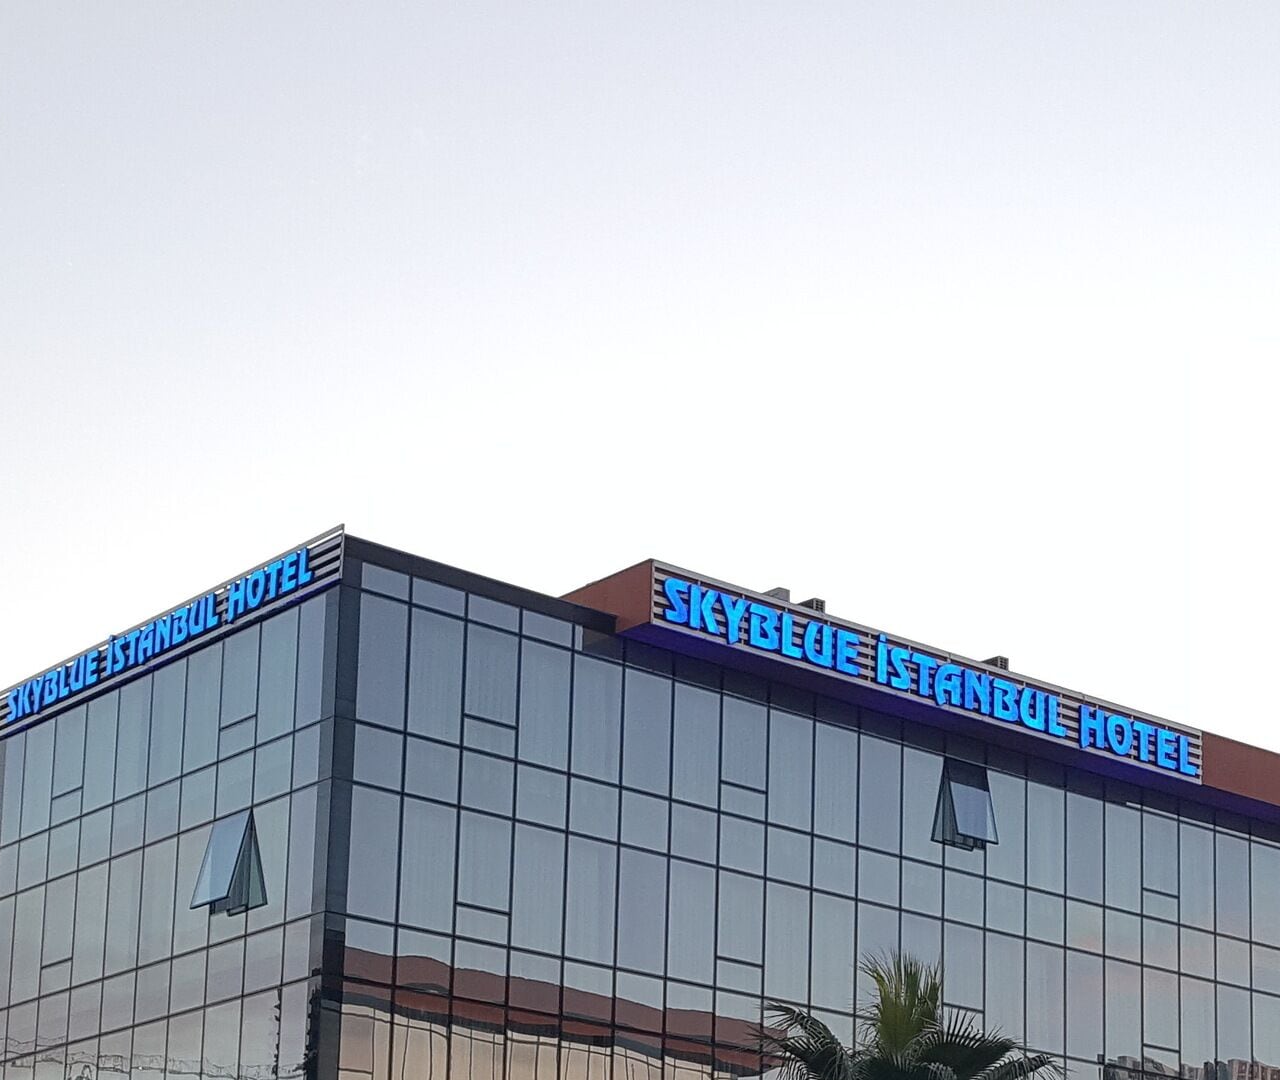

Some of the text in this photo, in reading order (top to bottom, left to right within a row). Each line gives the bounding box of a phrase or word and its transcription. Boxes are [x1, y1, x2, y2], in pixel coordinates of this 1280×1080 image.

[5, 650, 100, 723] SKYBLUE
[227, 547, 314, 624] HOTEL
[662, 577, 860, 677] SKYBLUE
[1079, 703, 1199, 777] HOTEL
